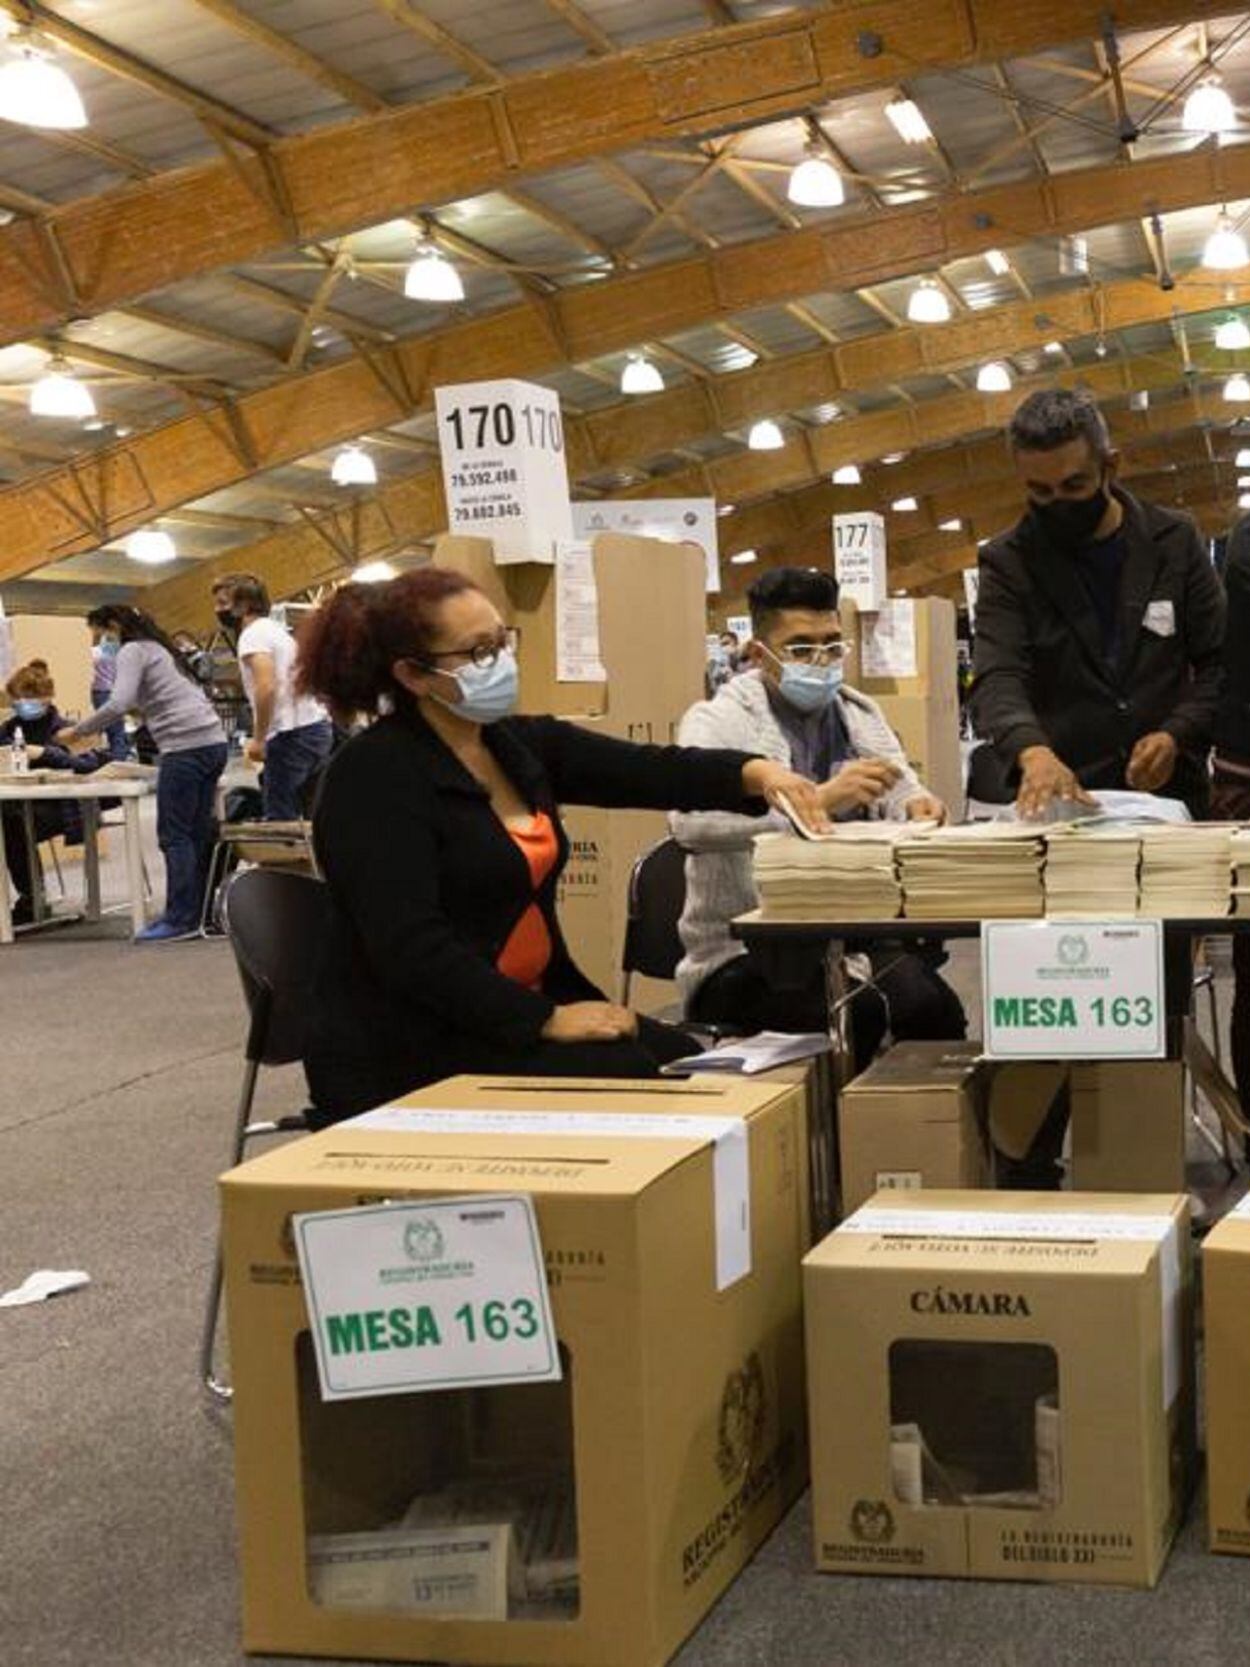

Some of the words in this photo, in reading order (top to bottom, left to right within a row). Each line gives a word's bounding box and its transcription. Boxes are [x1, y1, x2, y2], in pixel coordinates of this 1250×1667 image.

[446, 402, 515, 450] 170
[521, 404, 562, 452] 170
[836, 523, 868, 548] 177
[993, 996, 1077, 1028] MESA
[1090, 995, 1154, 1027] 163
[909, 1284, 1032, 1316] CÁMARA
[325, 1304, 442, 1356] MESA
[455, 1297, 540, 1343] 163
